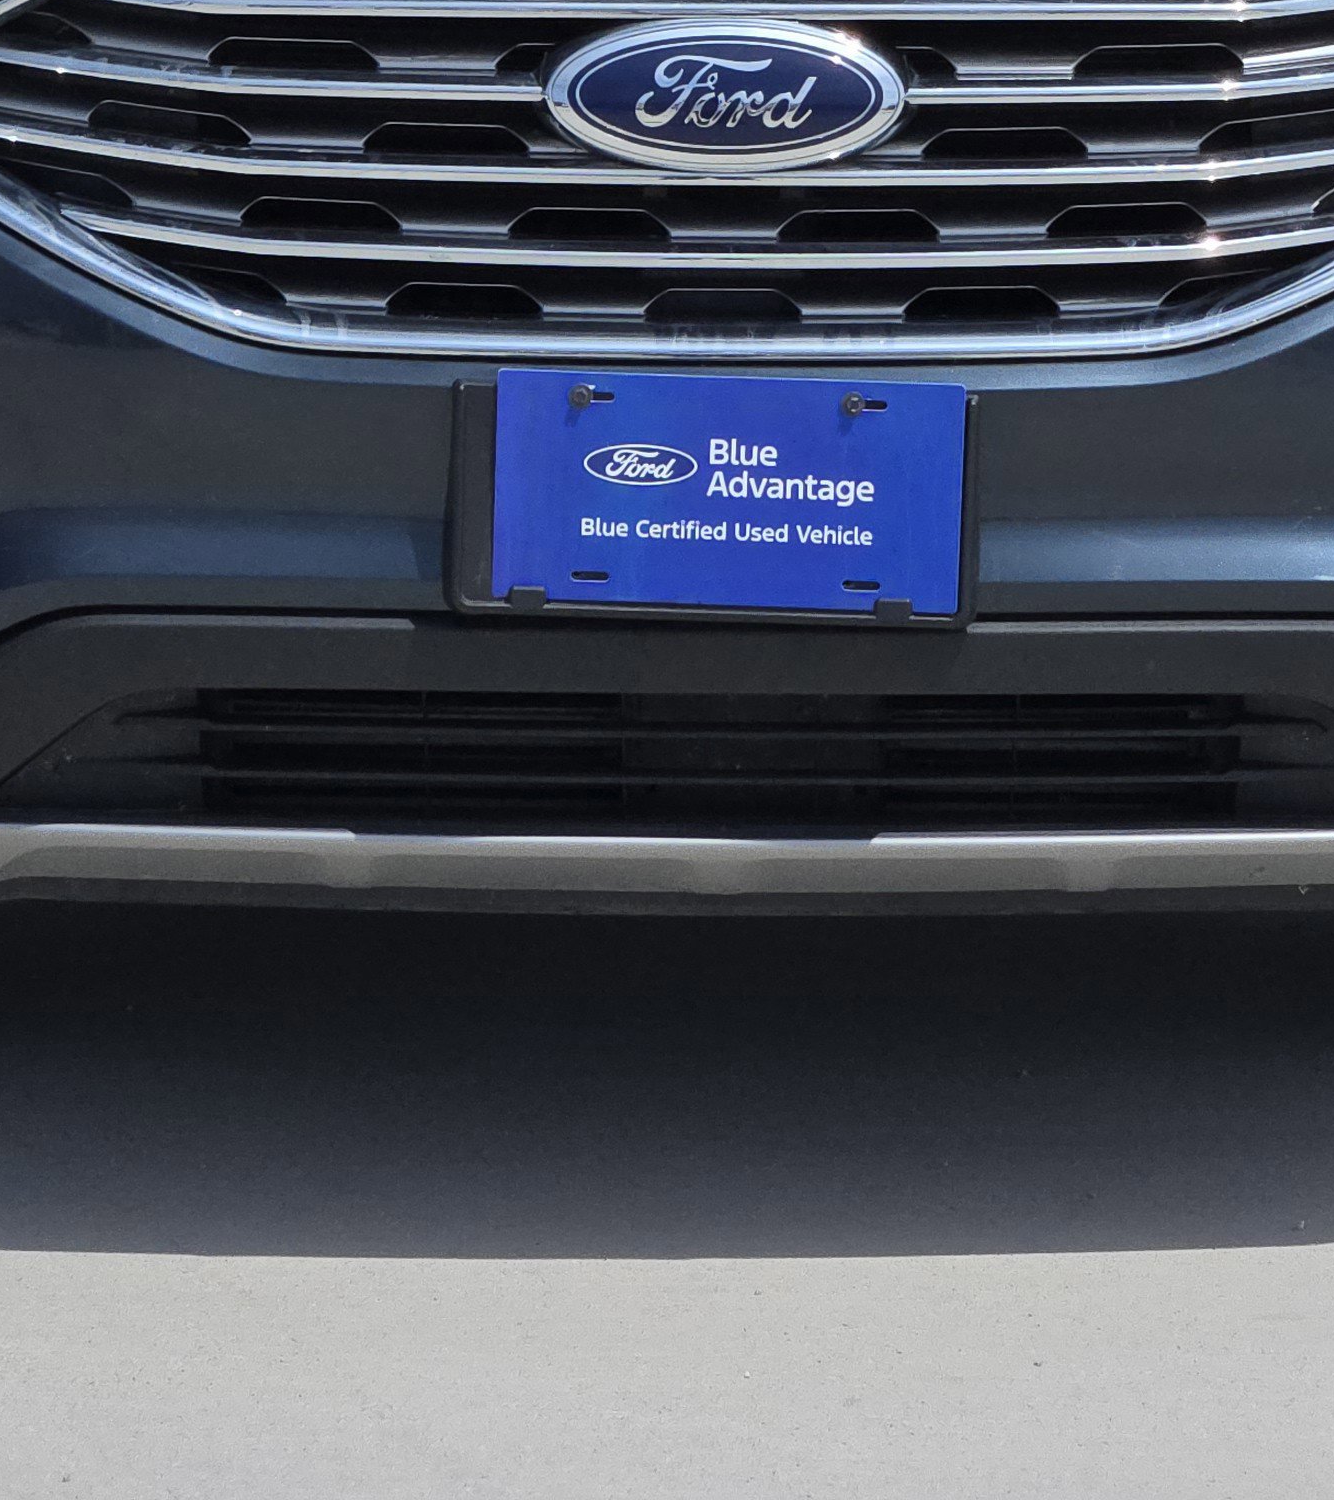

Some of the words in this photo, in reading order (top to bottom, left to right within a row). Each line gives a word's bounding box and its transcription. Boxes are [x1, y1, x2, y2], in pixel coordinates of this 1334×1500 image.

[634, 55, 817, 129] Ford
[605, 450, 676, 479] Ford
[709, 438, 778, 467] Blue
[706, 470, 875, 507] Advantage
[581, 517, 628, 538] Blue
[635, 518, 727, 541] Certified
[734, 522, 789, 544] Used
[795, 525, 873, 546] Vehicle
